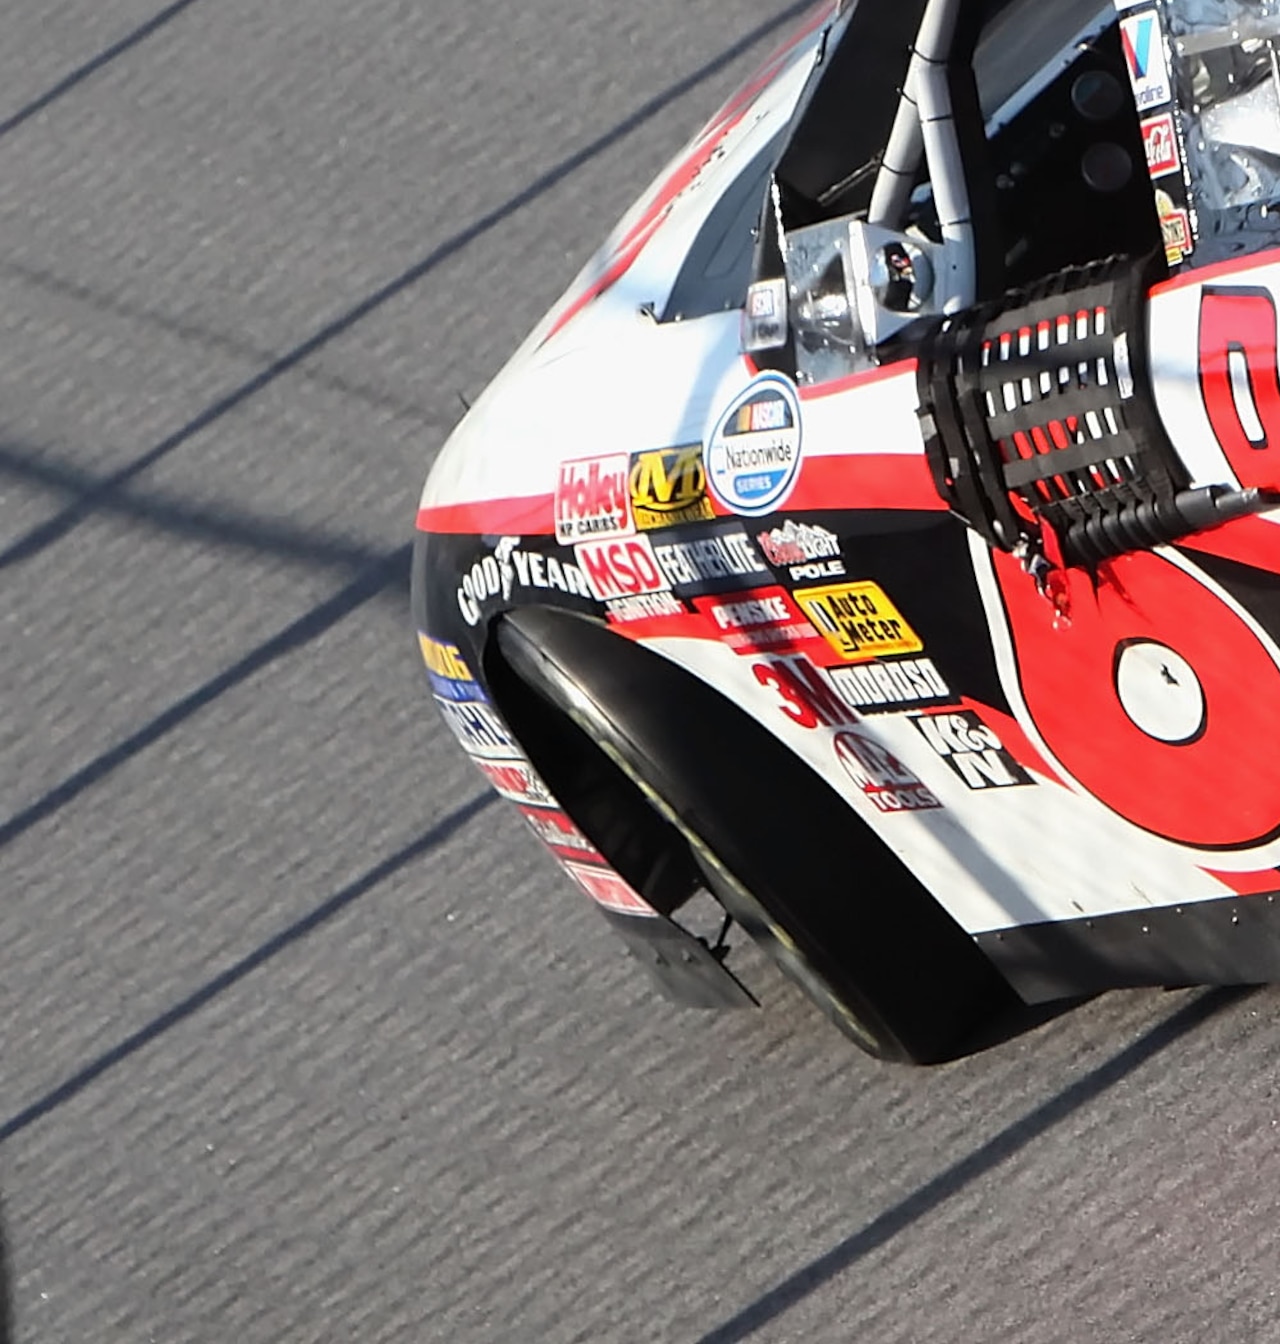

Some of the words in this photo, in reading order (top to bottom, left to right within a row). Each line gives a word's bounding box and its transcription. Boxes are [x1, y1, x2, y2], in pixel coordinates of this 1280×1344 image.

[725, 438, 792, 470] Nationwide
[558, 462, 628, 529] Holley
[582, 542, 662, 597] MSD
[788, 560, 846, 581] POLE
[711, 596, 791, 629] PENSKE
[827, 591, 878, 619] Auto
[840, 617, 901, 651] Meter
[752, 656, 860, 729] 3M
[828, 658, 950, 707] MOROSO
[867, 788, 940, 811] TOOLS
